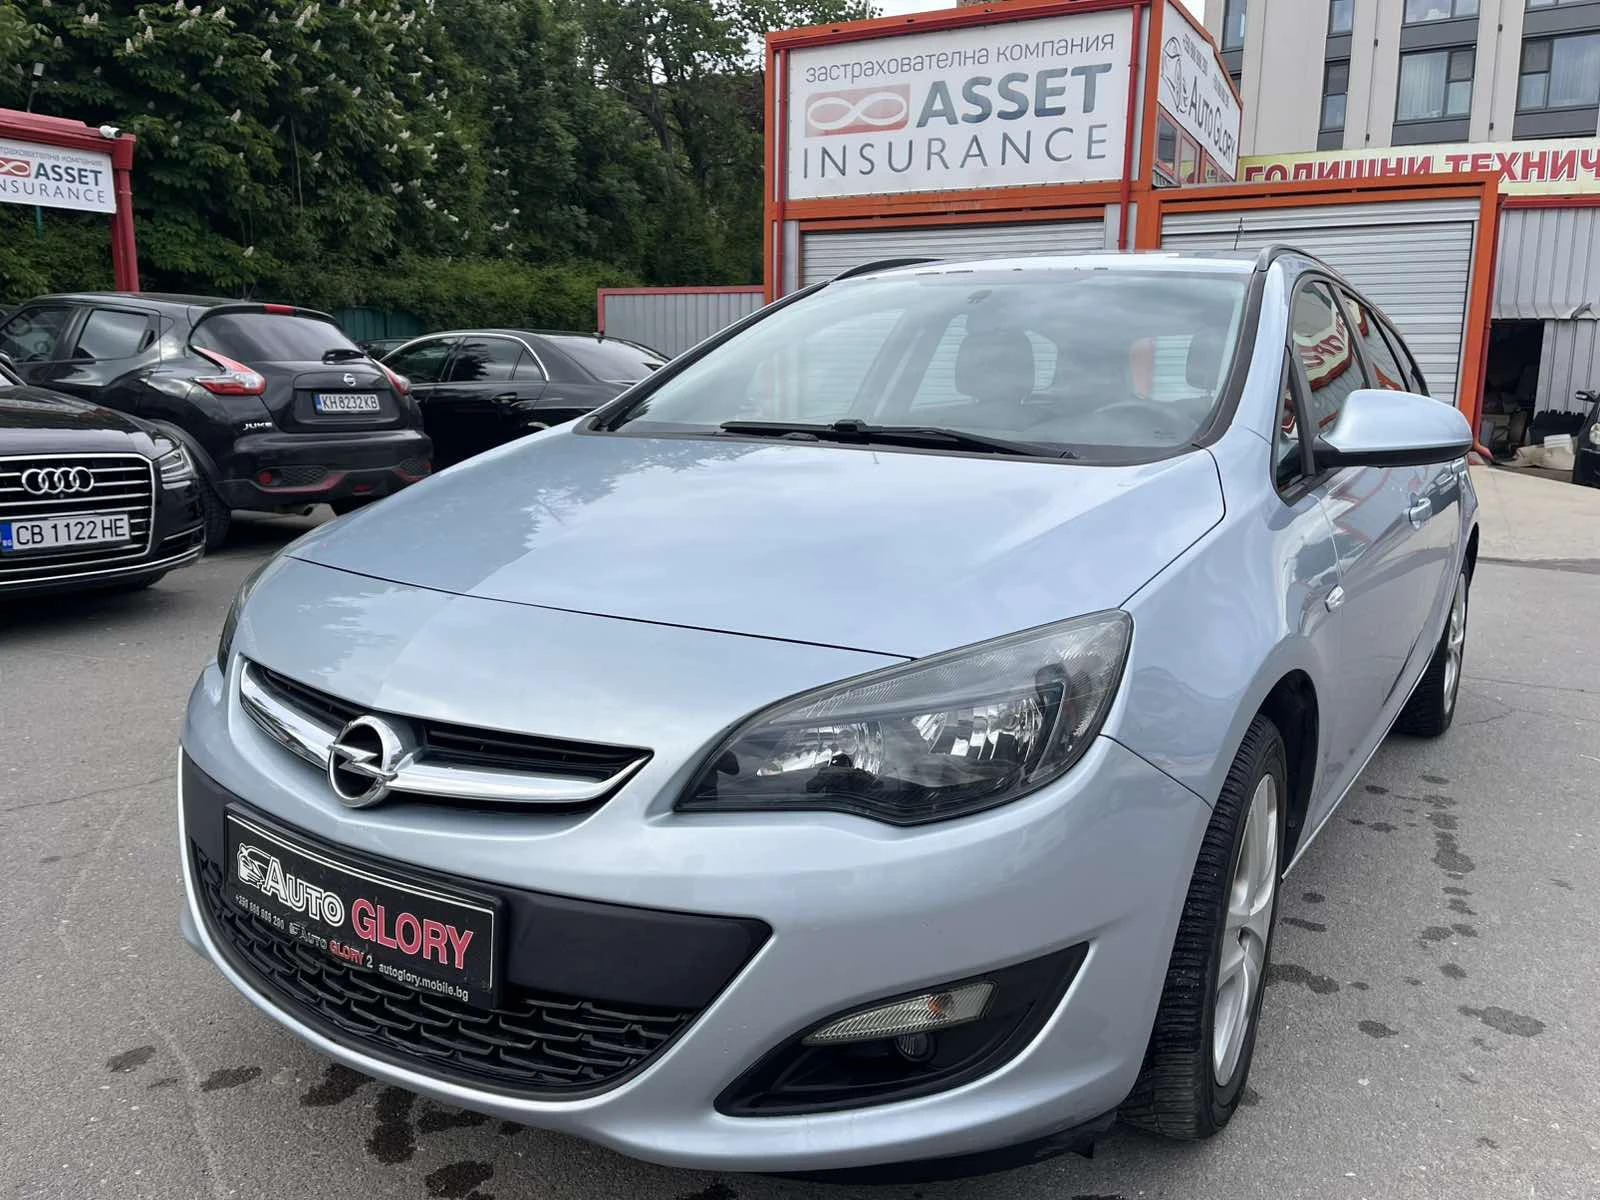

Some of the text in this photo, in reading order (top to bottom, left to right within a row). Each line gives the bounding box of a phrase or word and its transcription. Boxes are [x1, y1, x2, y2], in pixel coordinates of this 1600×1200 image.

[805, 32, 1114, 84] застрахователна компания
[915, 62, 1112, 128] ASSET
[34, 162, 102, 187] ASSET
[803, 123, 1108, 179] INSURANCE
[242, 421, 273, 431] JUKE
[16, 524, 44, 545] CB
[51, 520, 98, 542] 1122
[101, 518, 126, 538] HE
[351, 898, 474, 970] GLORY
[328, 939, 365, 967] GLORY
[366, 953, 374, 969] 2
[378, 961, 469, 1002] autoglory.mobile.bg
